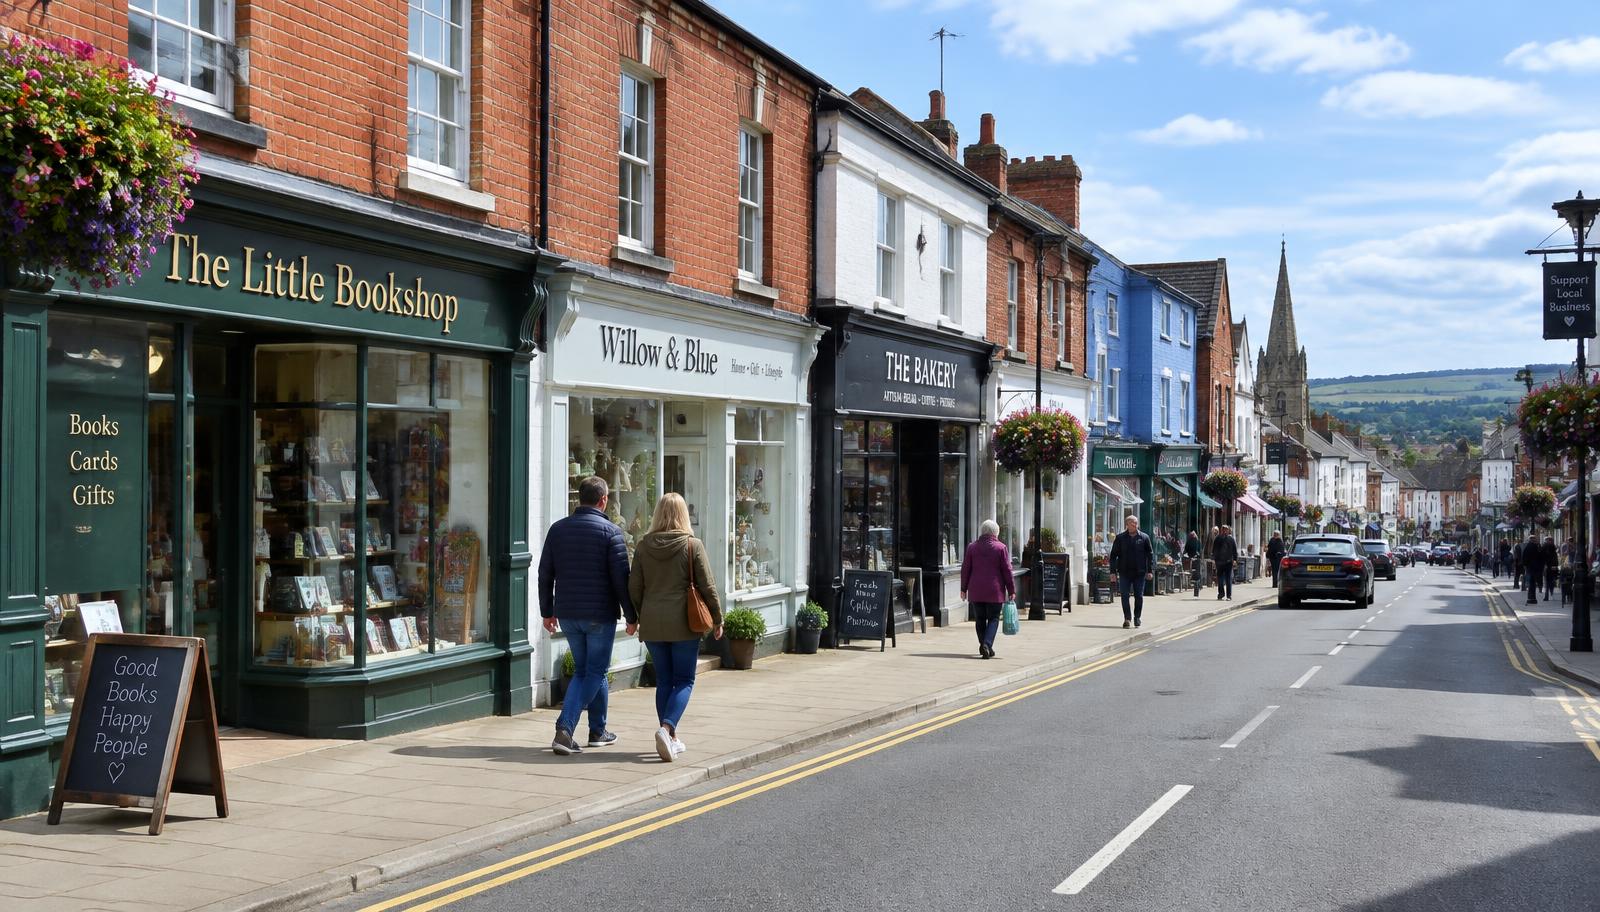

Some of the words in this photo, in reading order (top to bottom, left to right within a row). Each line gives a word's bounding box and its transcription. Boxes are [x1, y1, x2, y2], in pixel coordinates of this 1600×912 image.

[166, 233, 230, 288] The
[242, 246, 325, 302] Little
[334, 263, 459, 334] Bookshop
[1550, 275, 1589, 287] Support
[1557, 288, 1583, 298] Local
[1550, 301, 1591, 312] Business
[600, 324, 662, 367] Willow
[666, 336, 680, 371] &
[684, 338, 718, 375] Blue
[885, 351, 910, 383] THE
[914, 356, 958, 389] BAKERY
[69, 413, 119, 436] Books
[70, 450, 118, 471] Cards
[73, 484, 115, 506] Gifts
[114, 655, 159, 677] Good
[107, 680, 158, 704] Books
[100, 706, 152, 734] Happy
[93, 732, 148, 760] People
